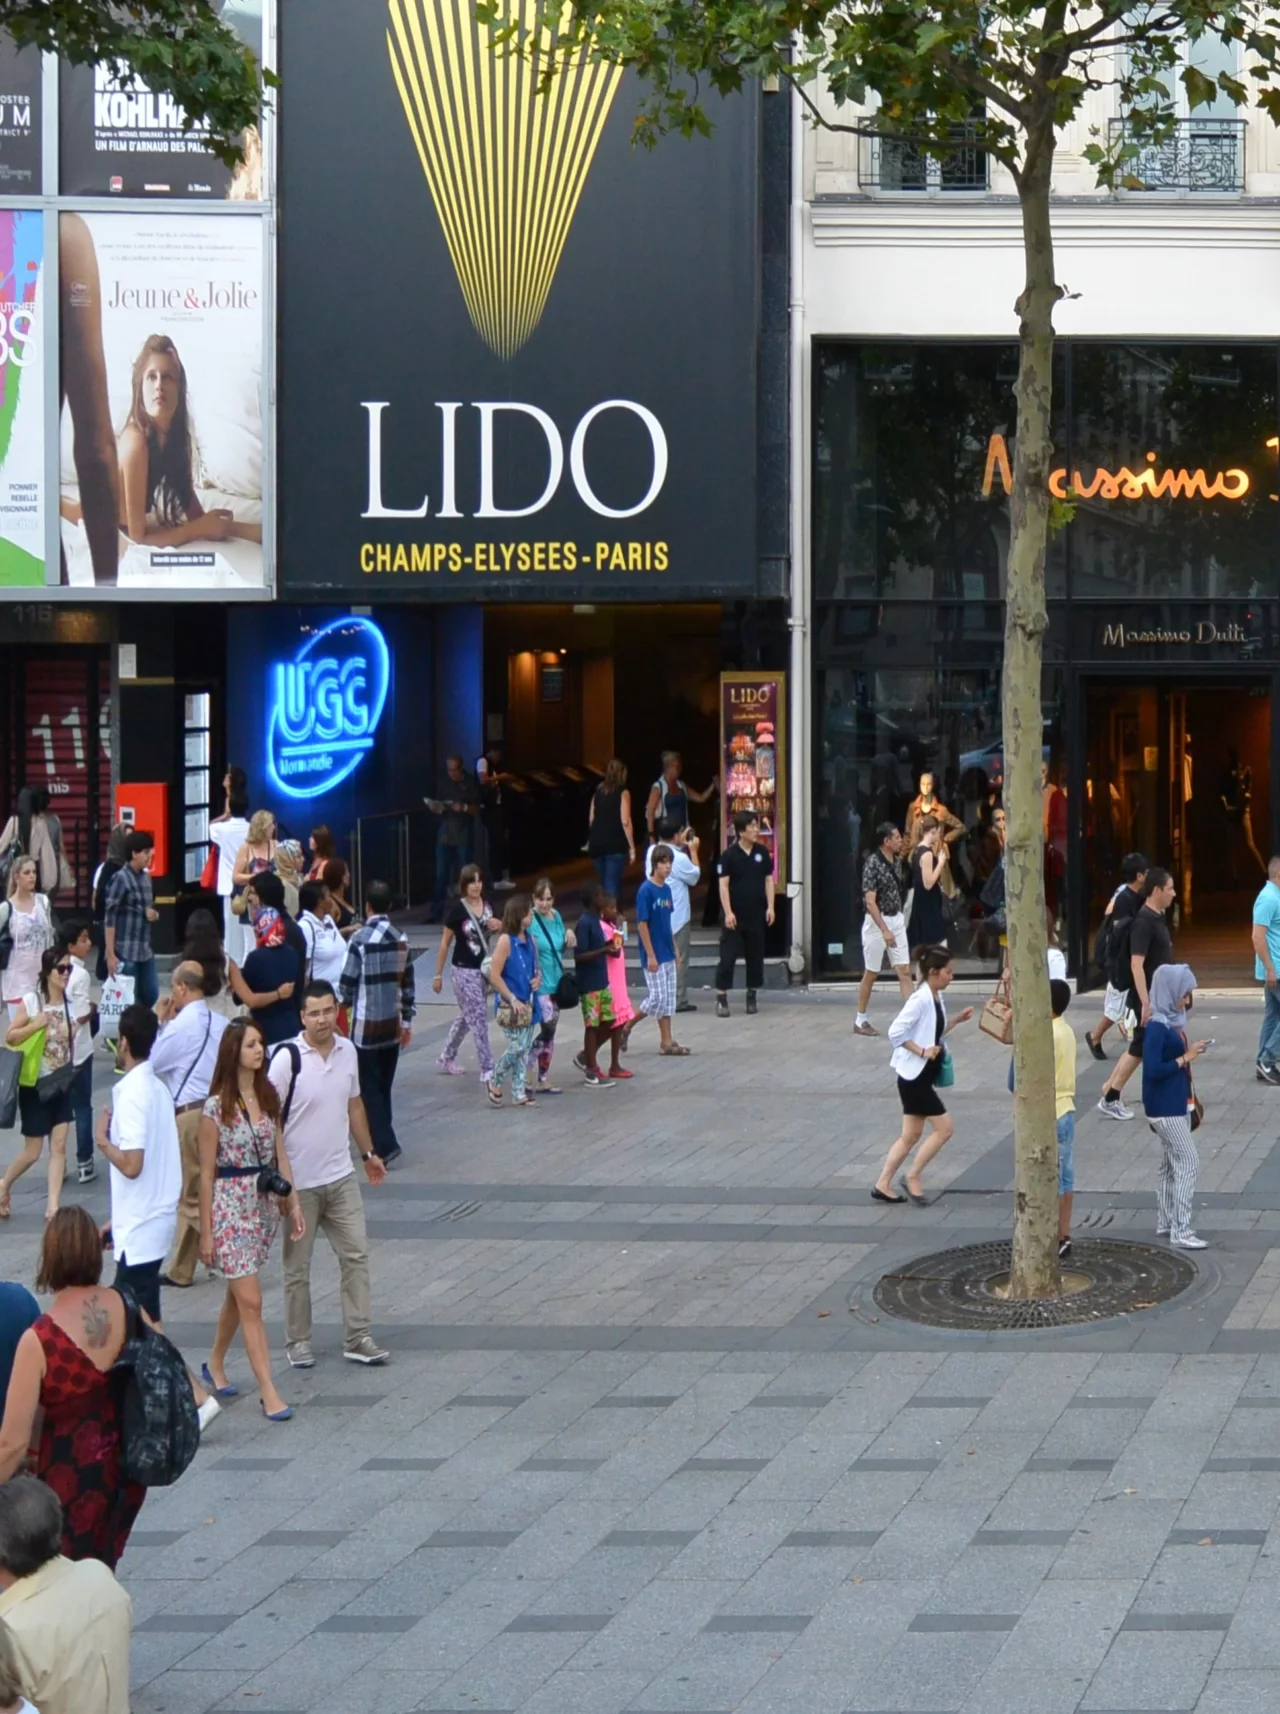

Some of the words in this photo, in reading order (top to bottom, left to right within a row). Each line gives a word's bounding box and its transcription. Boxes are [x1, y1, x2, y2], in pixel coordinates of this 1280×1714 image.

[94, 139, 106, 151] UN
[108, 139, 127, 151] FILM
[129, 140, 169, 152] D'ARNAUD
[170, 142, 186, 152] DES
[360, 399, 669, 519] LIDO
[8, 483, 38, 491] PIONNIER
[11, 494, 38, 502] REBELLE
[1103, 623, 1191, 649] Massimo
[1195, 621, 1247, 646] Dutti
[276, 656, 369, 742] UGC
[730, 686, 770, 703] LIDO
